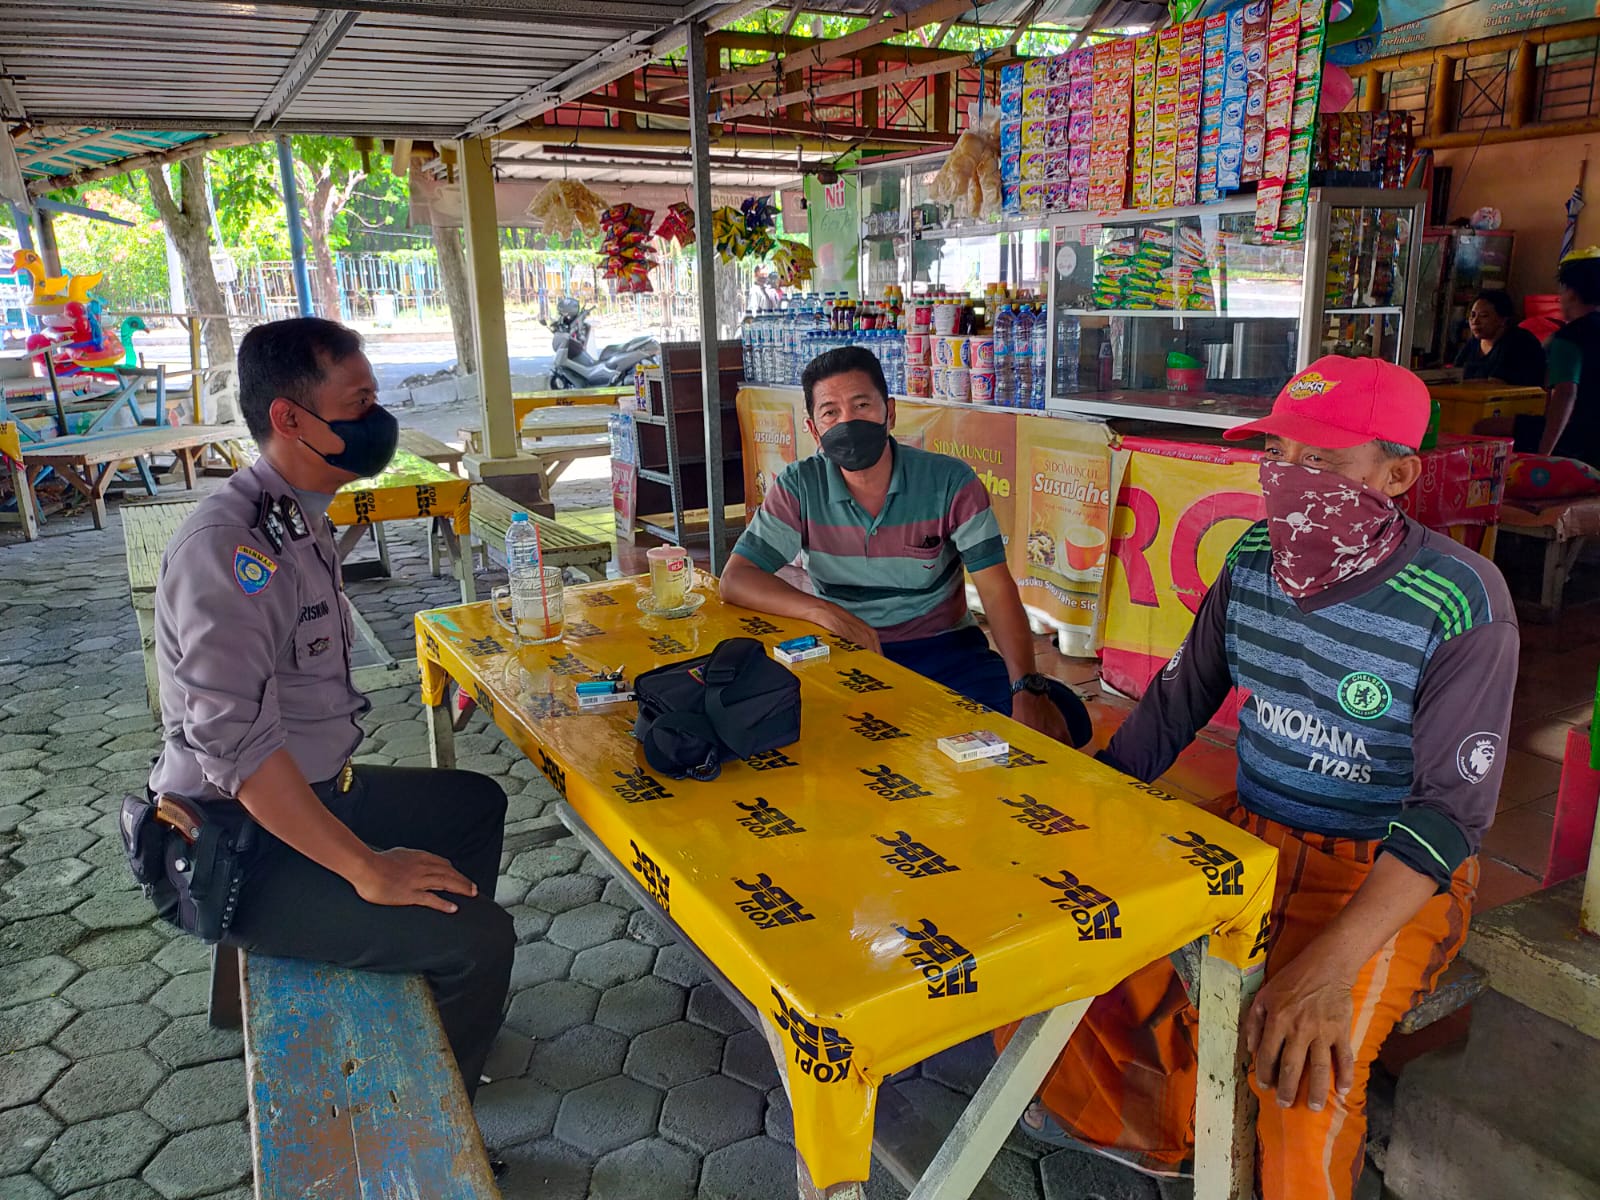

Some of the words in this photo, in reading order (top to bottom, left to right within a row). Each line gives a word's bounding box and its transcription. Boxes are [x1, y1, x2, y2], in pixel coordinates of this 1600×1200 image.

[1033, 472, 1109, 506] SusuJahe
[837, 668, 894, 692] ABC
[839, 680, 870, 693] KOPI
[1352, 675, 1385, 691] CHELSEA
[845, 712, 911, 739] ABC
[850, 726, 885, 742] KOPI
[1254, 694, 1371, 761] YOKOHAMA
[614, 767, 674, 799] ABC
[859, 764, 934, 798] ABC
[1308, 752, 1372, 784] TYRES
[612, 784, 644, 803] KOPI
[864, 782, 901, 802] KOPI
[1128, 781, 1177, 802] KOPI
[735, 797, 807, 837] ABC
[736, 817, 775, 839] KOPI
[1002, 794, 1090, 833] ABC
[1010, 814, 1059, 836] KOPI
[875, 830, 962, 876] ABC
[880, 854, 928, 879] KOPI
[1168, 831, 1245, 896] ABC
[1180, 855, 1221, 896] KOPI
[734, 873, 816, 926] ABC
[735, 900, 779, 930] KOPI
[1039, 870, 1122, 941] ABC
[1050, 898, 1094, 942] KOPI
[896, 918, 978, 997] ABC
[903, 950, 946, 999] KOPI
[771, 985, 854, 1063] ABC
[795, 1048, 851, 1084] KOPI
